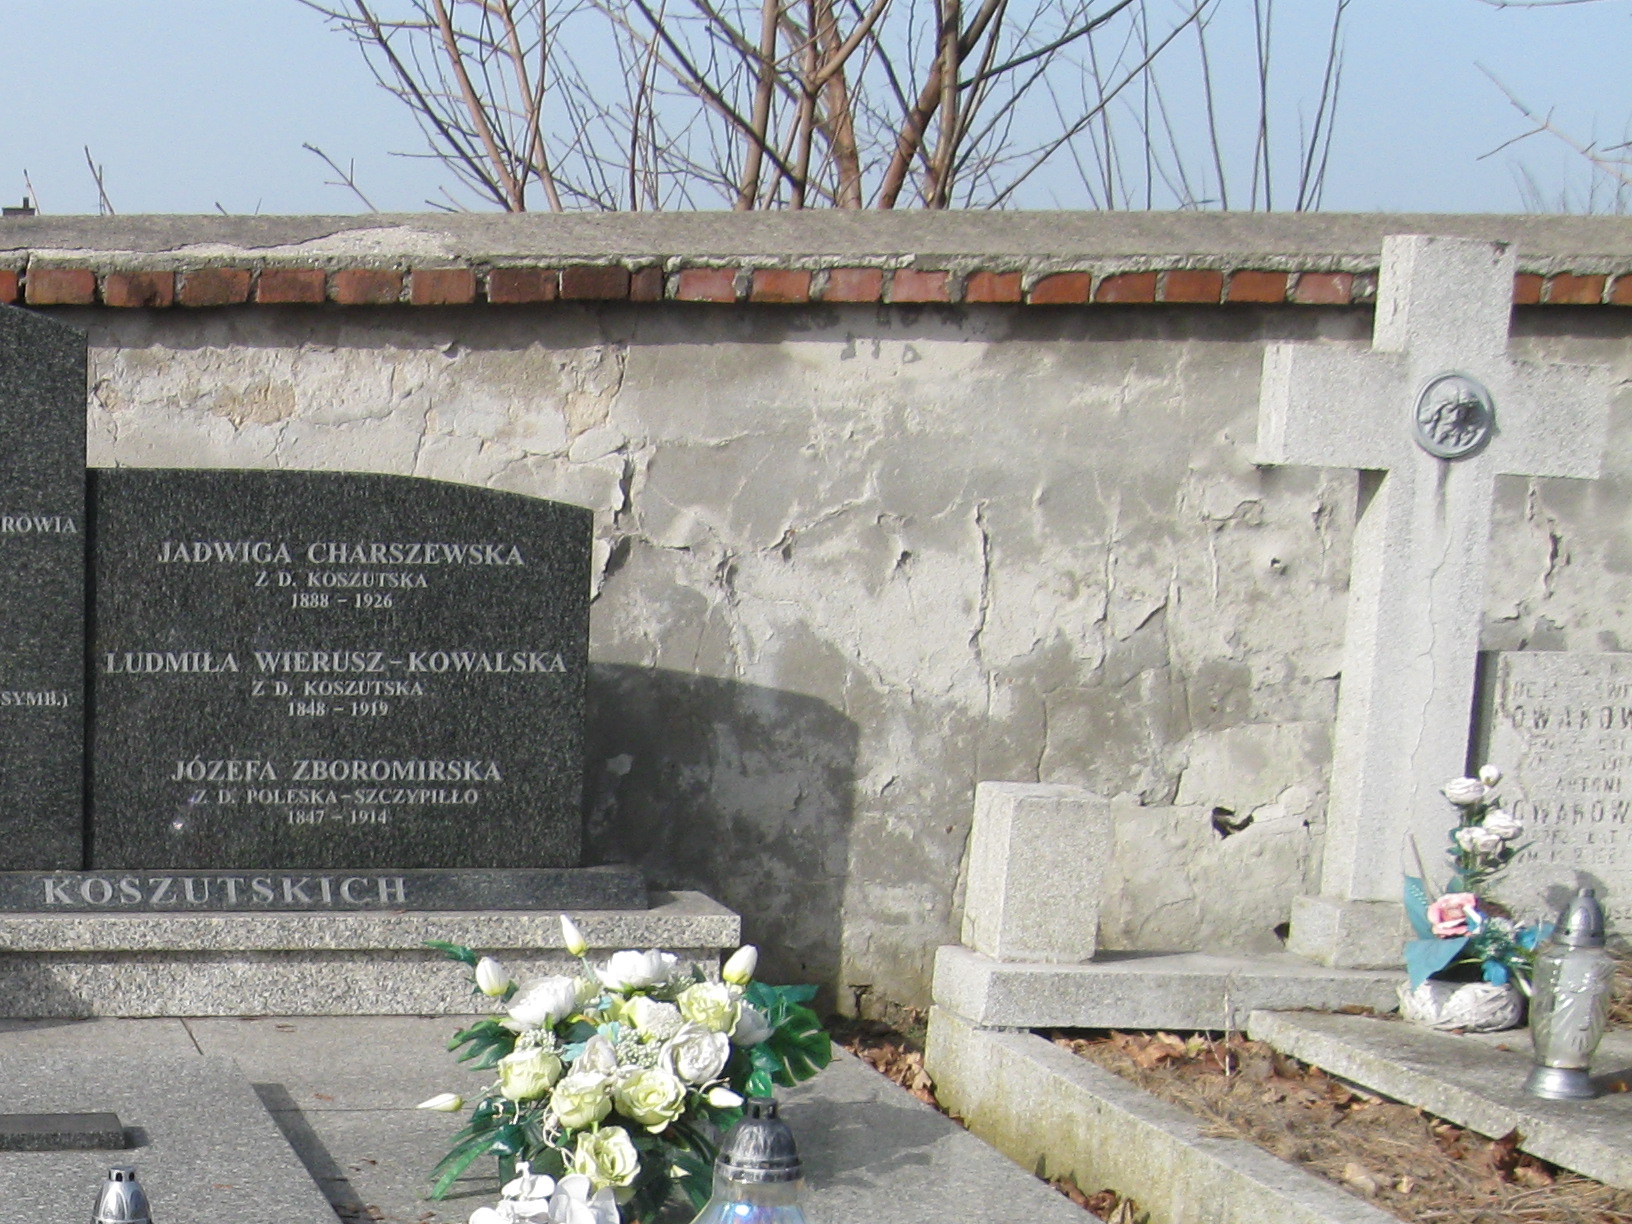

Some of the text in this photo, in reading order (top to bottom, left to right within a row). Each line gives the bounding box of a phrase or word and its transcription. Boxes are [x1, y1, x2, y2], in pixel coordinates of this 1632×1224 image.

[156, 541, 526, 566] JADWIGA CHARSZEWSKA
[254, 572, 429, 589] Z D. KOSZUTSKA
[291, 592, 329, 609] 1888
[354, 592, 393, 609] 1926
[104, 652, 241, 675] LUDMIŁA
[251, 680, 424, 696] Z D. KOSZUTSKA
[287, 701, 326, 717] 1848
[350, 701, 389, 717] 1919
[170, 754, 504, 782] JÓZEFA ZBOROMIRSKA
[193, 789, 208, 805] Z
[218, 789, 236, 805] D.
[286, 809, 325, 825] 1847
[349, 809, 387, 825] 1914
[42, 876, 408, 905] KOSZUTSKICH
